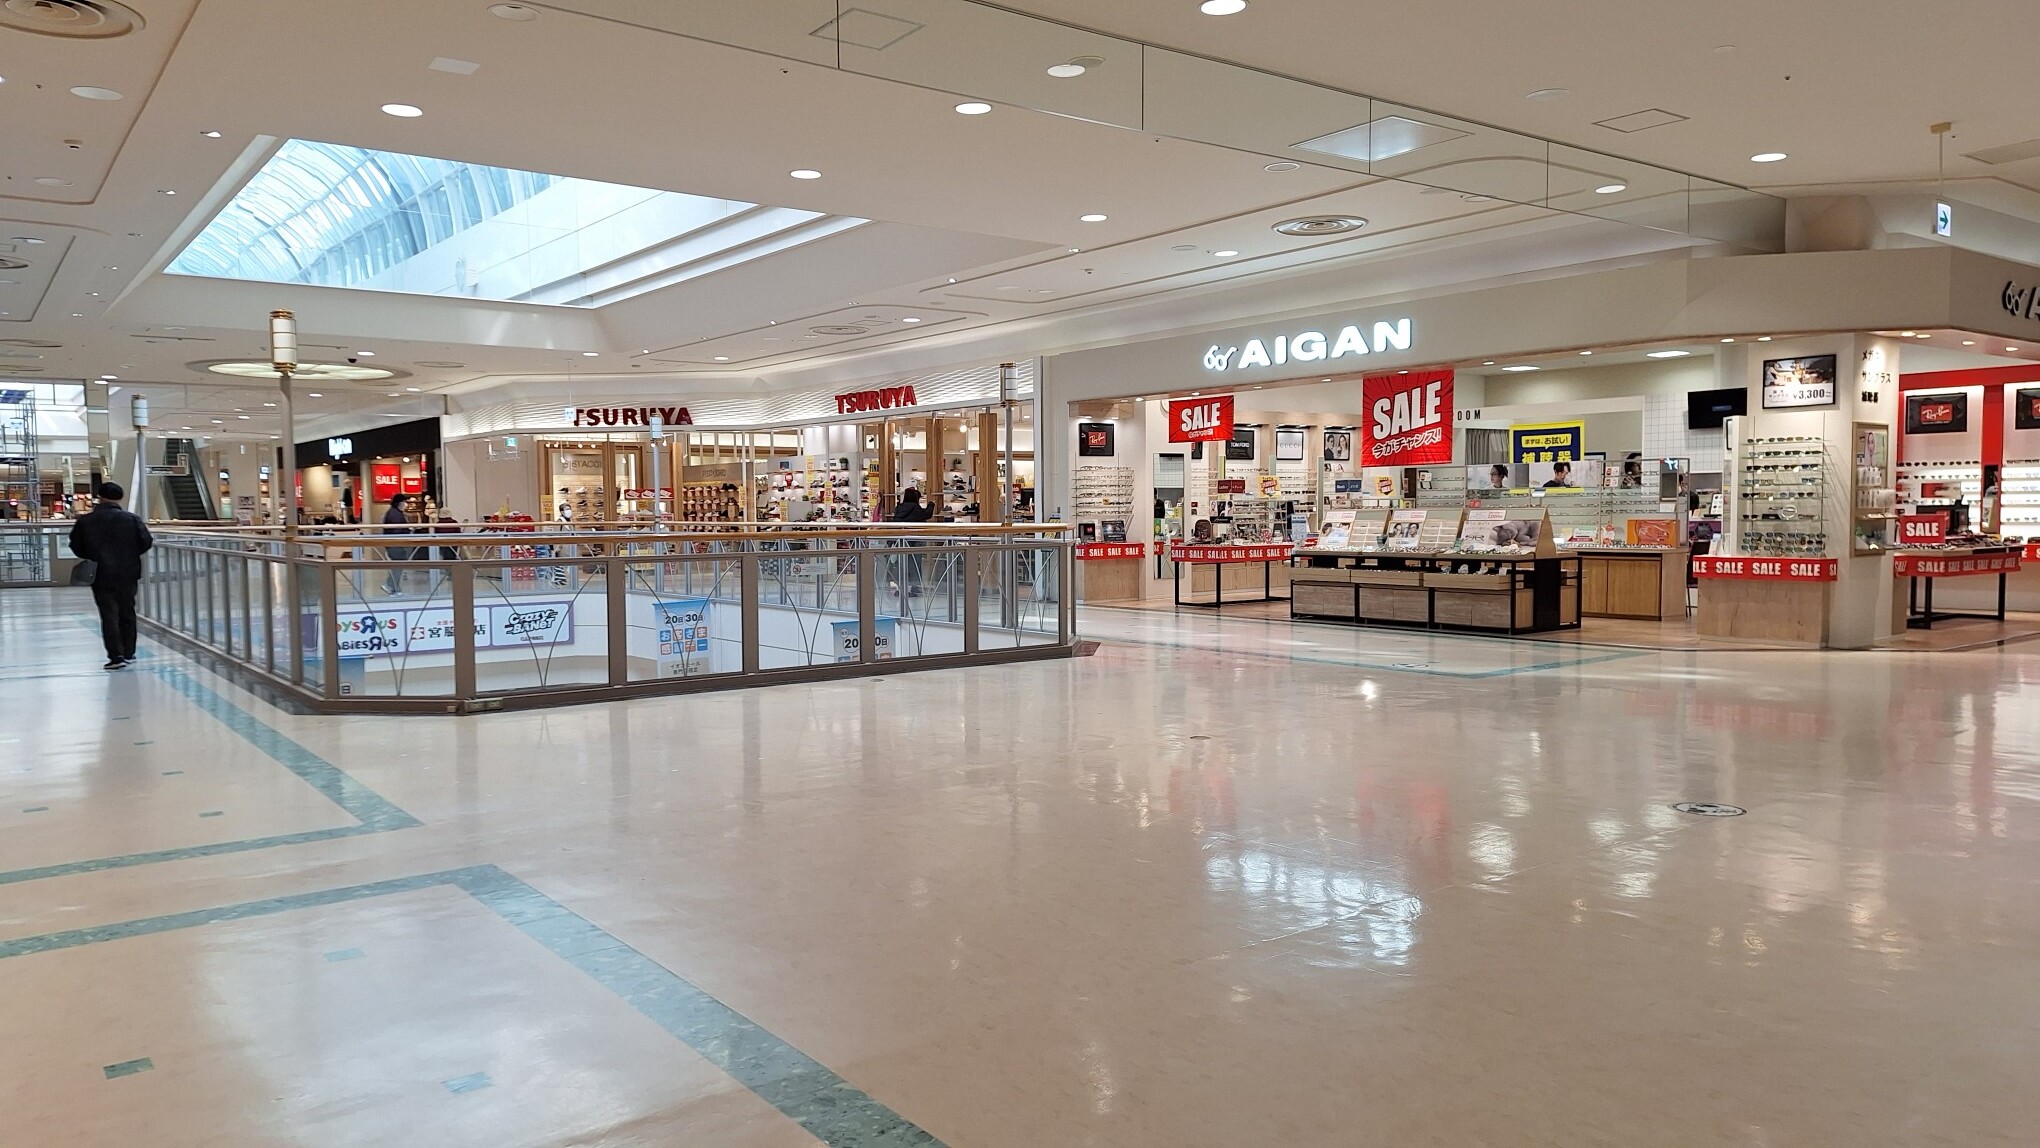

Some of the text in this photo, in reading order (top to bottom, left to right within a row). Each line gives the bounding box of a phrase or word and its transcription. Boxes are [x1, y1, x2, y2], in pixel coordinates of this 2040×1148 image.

[1238, 318, 1411, 369] AIGAN
[834, 385, 917, 414] TSURUYA
[574, 407, 693, 426] TSURUYA
[1181, 402, 1220, 432] SALE
[1372, 380, 1441, 440] SALE
[1457, 409, 1481, 420] OOM
[1372, 427, 1442, 459] 今がチャンス!
[375, 475, 398, 485] SALE
[1906, 522, 1939, 537] SALE
[1076, 548, 1084, 557] ALE
[1089, 548, 1104, 557] SALE
[1107, 547, 1121, 556] SALE
[1125, 547, 1139, 555] SALE
[1171, 549, 1185, 558] SALE
[1189, 549, 1204, 558] SALE
[1231, 549, 1245, 558] SALE
[1249, 549, 1263, 558] SALE
[1267, 548, 1280, 557] SALE
[1715, 561, 1743, 574] SALE
[1752, 562, 1781, 575] SALE
[1790, 563, 1820, 576] SALE
[1918, 561, 1946, 573] SALE
[508, 609, 556, 625] Crazy
[665, 613, 703, 625] 20日 30日
[874, 636, 888, 647] 0日
